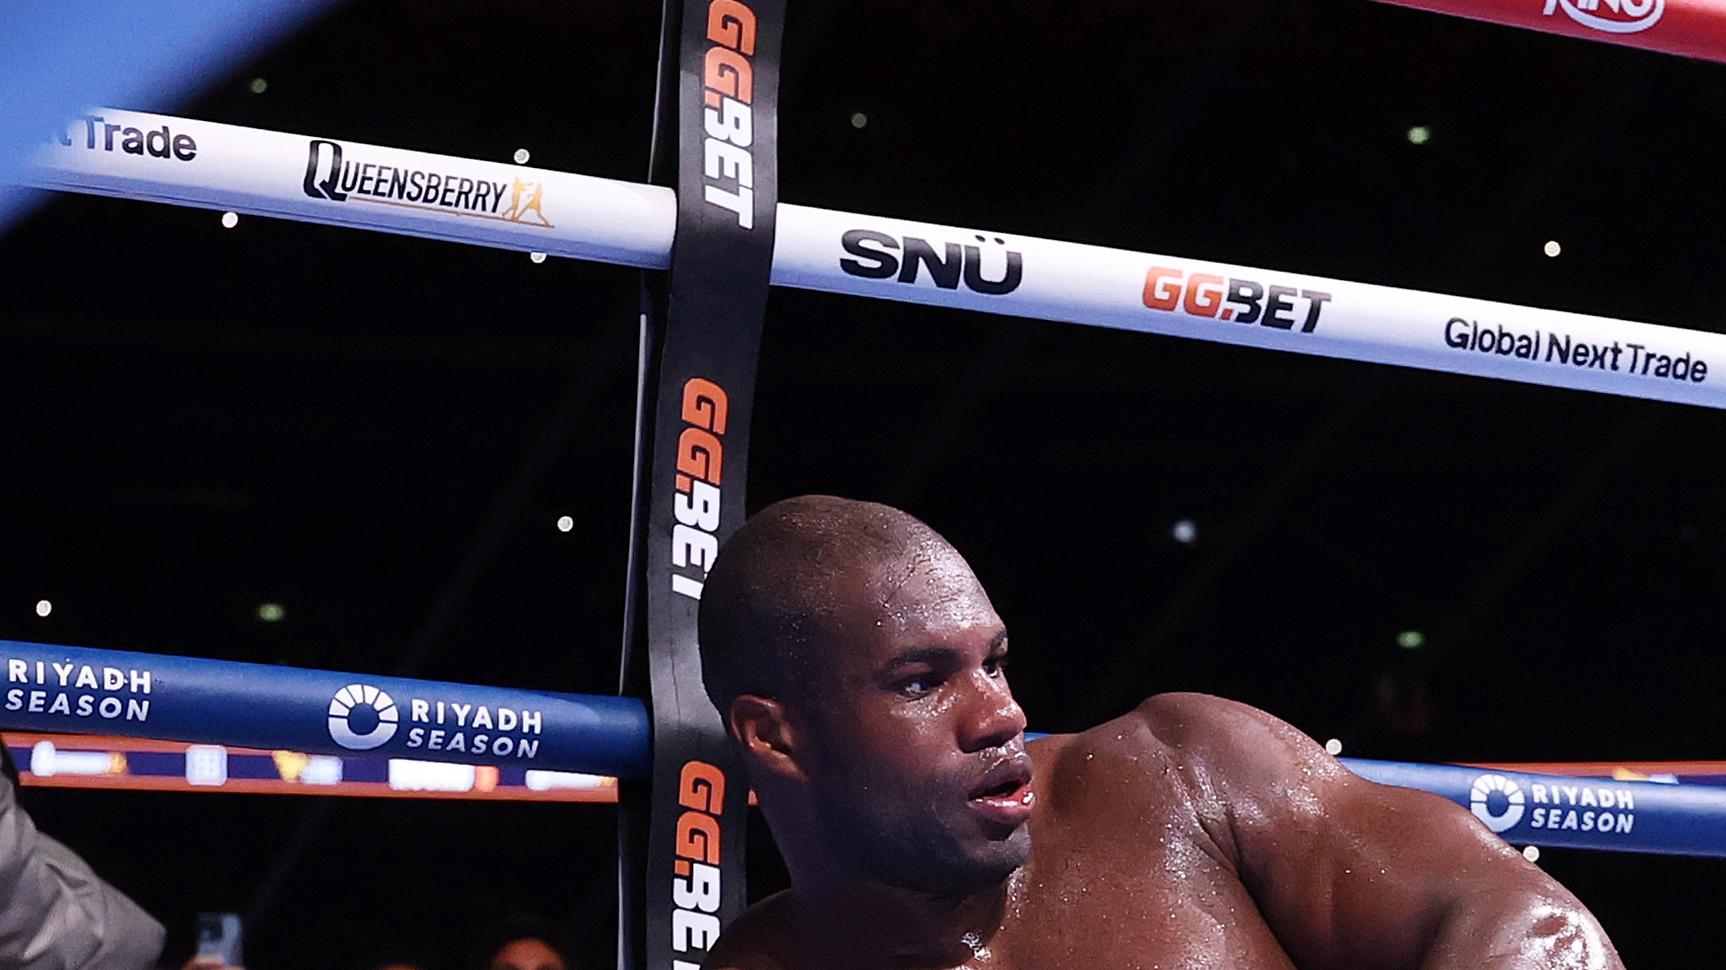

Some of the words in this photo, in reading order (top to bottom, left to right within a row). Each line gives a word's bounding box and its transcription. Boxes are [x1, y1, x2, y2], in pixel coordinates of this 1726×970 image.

[84, 115, 198, 162] Trade
[303, 139, 507, 214] QUEENSBERRY
[840, 228, 1023, 296] SNÜ
[1444, 317, 1541, 362] Global
[1546, 333, 1622, 371] Next
[1626, 343, 1708, 384] Trade
[9, 658, 152, 694] RIYADH
[3, 689, 150, 722] SEASON
[411, 699, 544, 735] RIYADH
[407, 727, 540, 760] SEASON
[1532, 784, 1635, 811] RIYADH
[1530, 808, 1635, 834] SEASON
